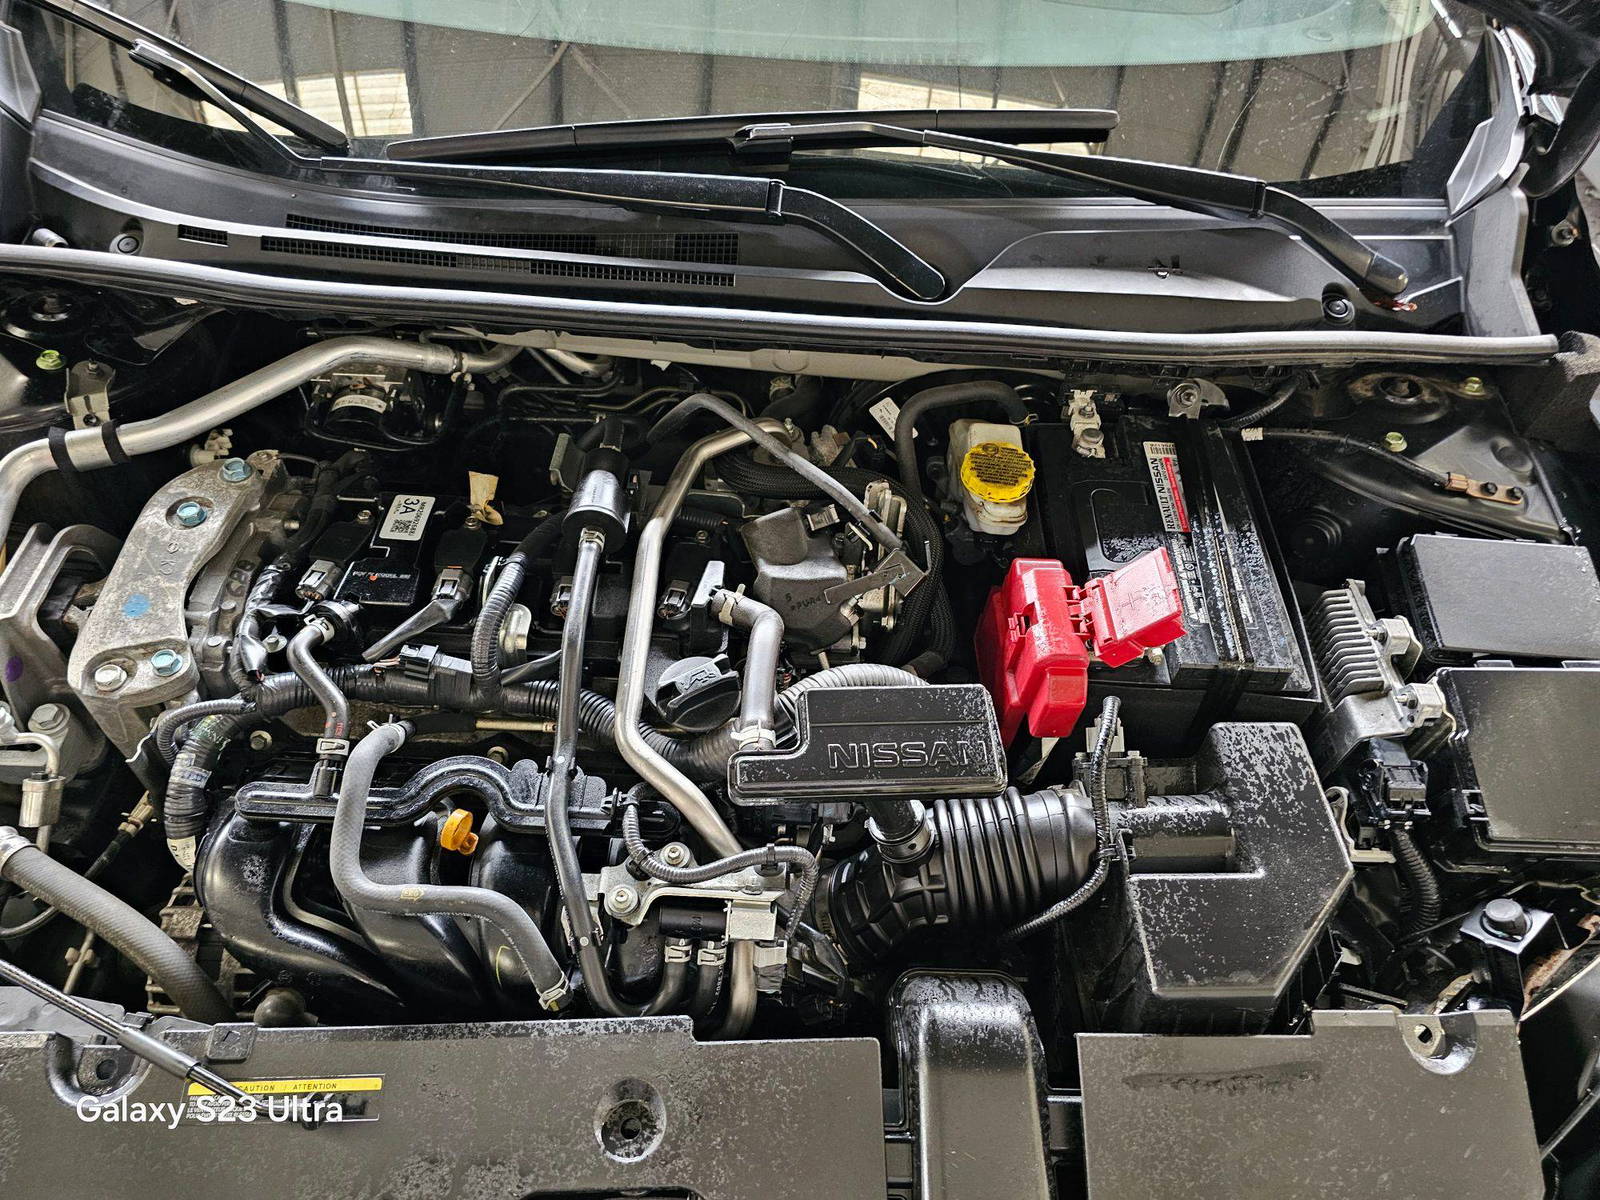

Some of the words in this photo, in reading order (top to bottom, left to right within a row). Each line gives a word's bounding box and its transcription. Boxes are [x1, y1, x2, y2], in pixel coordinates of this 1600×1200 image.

[1150, 457, 1166, 494] NISSAN
[400, 498, 420, 514] 3A
[1158, 494, 1175, 530] RENAULT
[828, 741, 988, 769] NISSAN
[293, 1083, 338, 1091] ATTENTION
